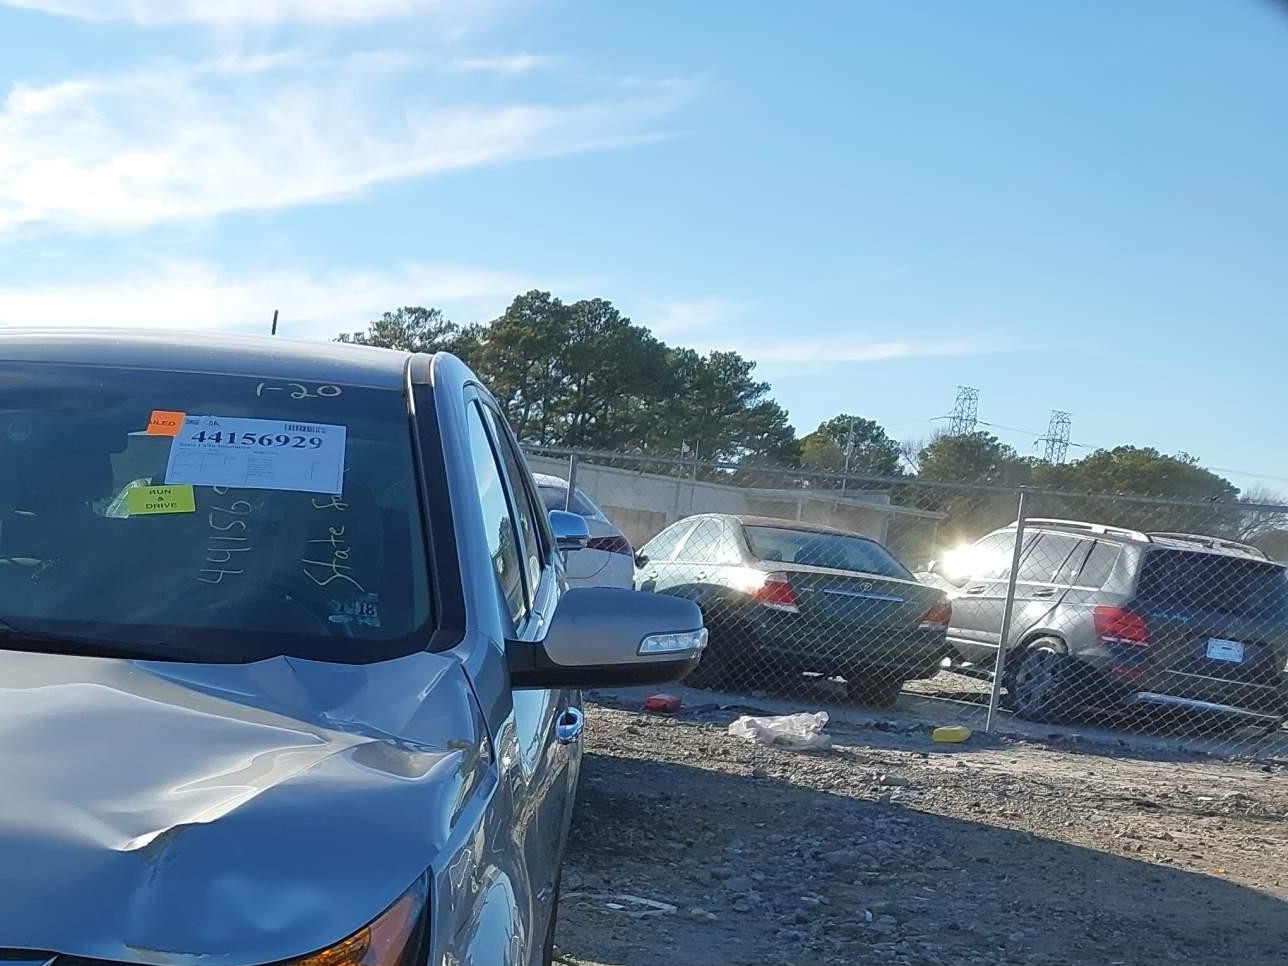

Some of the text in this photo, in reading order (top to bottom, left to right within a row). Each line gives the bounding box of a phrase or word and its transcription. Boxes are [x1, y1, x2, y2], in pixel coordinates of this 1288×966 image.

[256, 382, 343, 399] 1-20
[191, 430, 324, 450] 44156929
[300, 525, 366, 592] State
